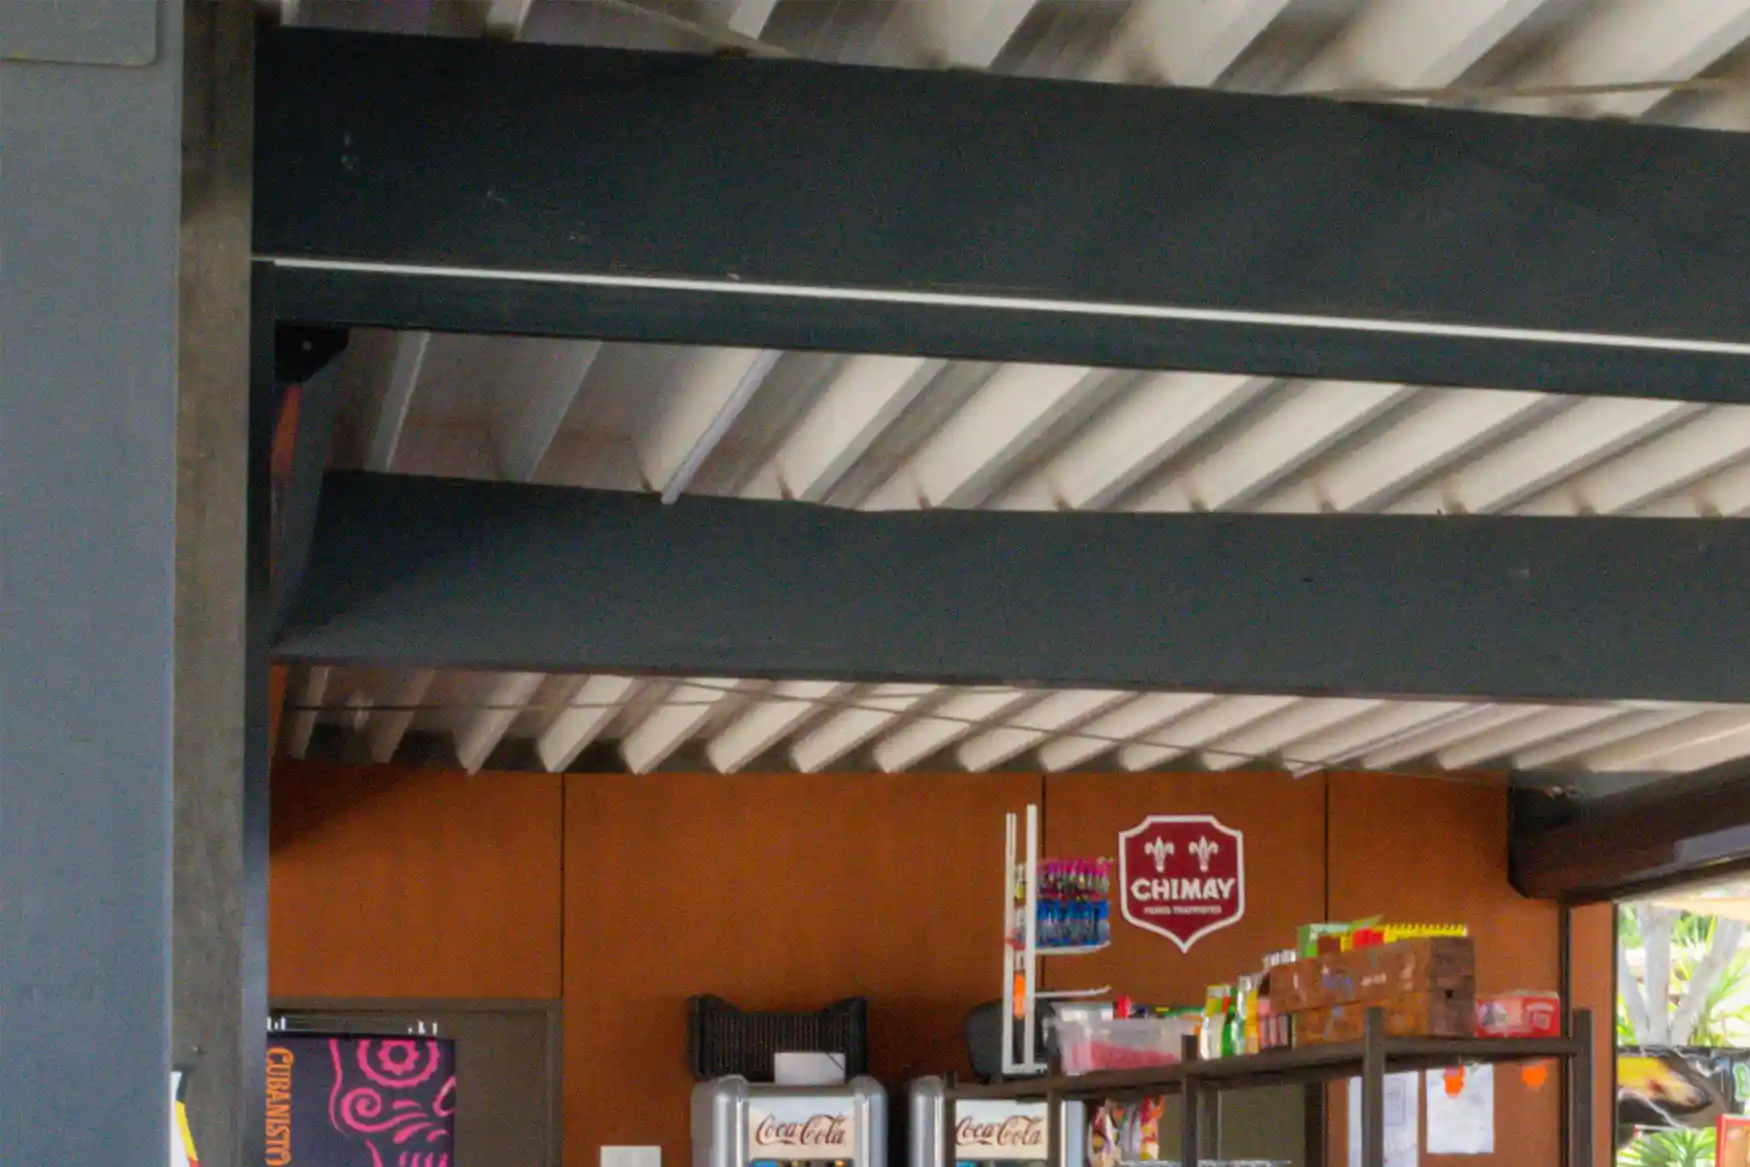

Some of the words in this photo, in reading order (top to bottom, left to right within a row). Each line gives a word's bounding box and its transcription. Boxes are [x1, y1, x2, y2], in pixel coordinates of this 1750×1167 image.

[1130, 877, 1237, 901] CHIMAY
[265, 1047, 294, 1166] CUBANISTO
[755, 1104, 846, 1146] Coca-Cola
[955, 1104, 1044, 1146] Coca-Cola
